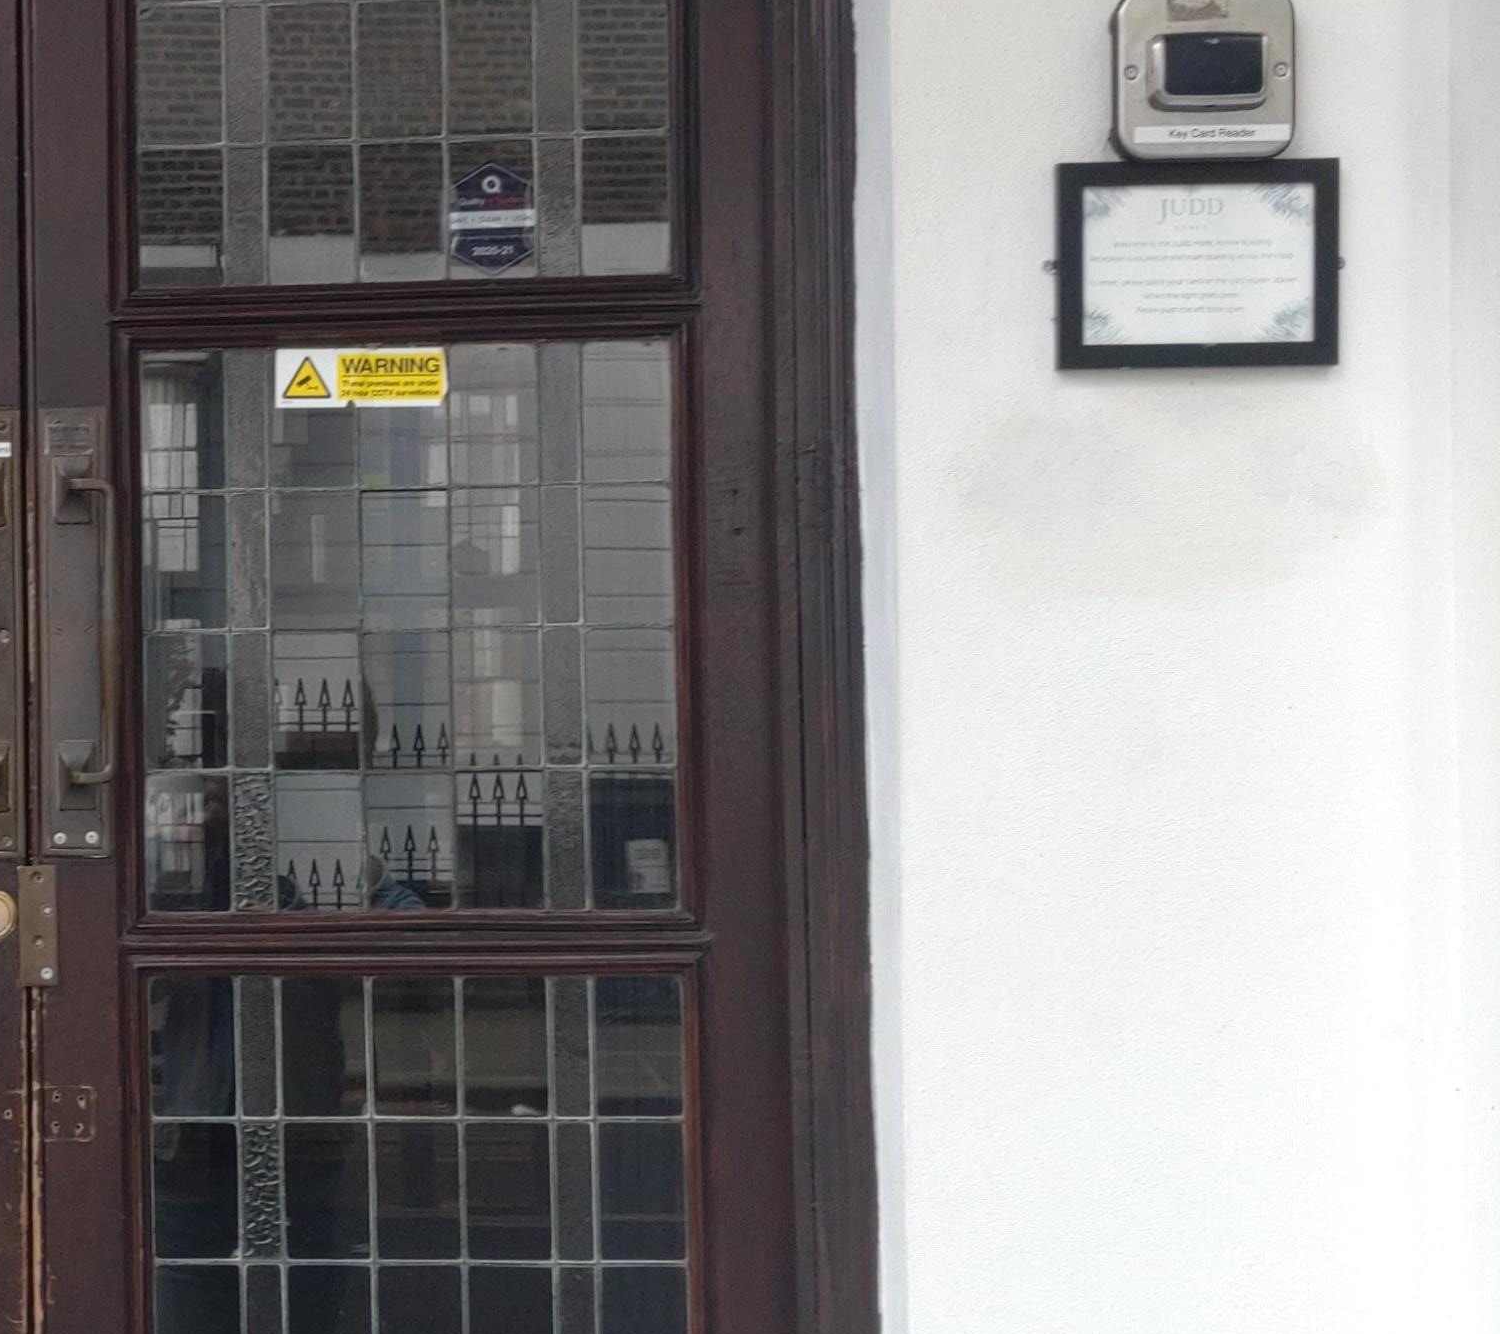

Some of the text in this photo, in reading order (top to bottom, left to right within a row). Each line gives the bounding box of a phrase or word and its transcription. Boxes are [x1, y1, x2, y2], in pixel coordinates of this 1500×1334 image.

[1168, 127, 1256, 140] Key Card Reader
[1156, 198, 1225, 226] JUDD
[342, 357, 441, 374] WARNING
